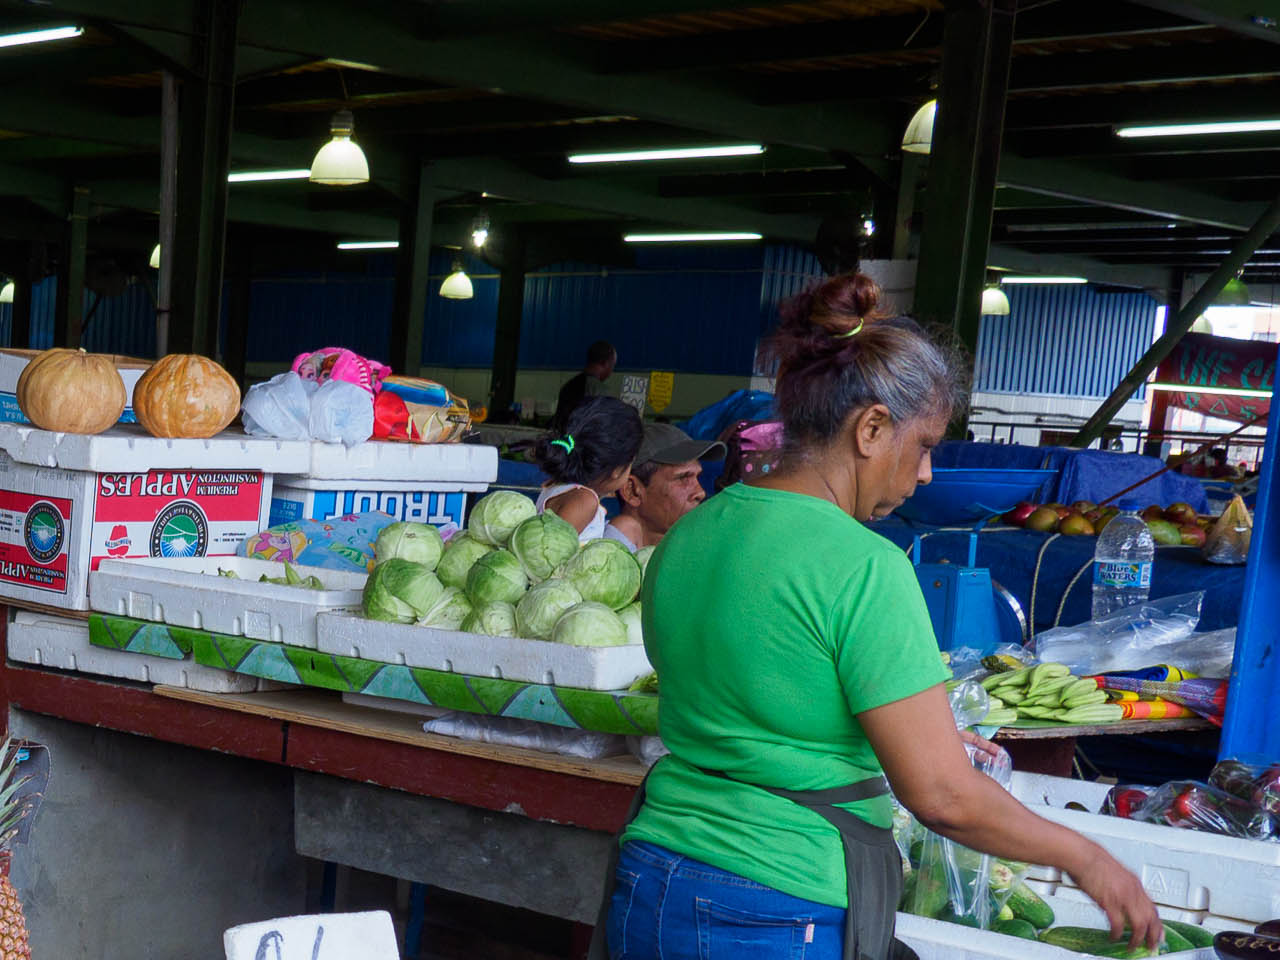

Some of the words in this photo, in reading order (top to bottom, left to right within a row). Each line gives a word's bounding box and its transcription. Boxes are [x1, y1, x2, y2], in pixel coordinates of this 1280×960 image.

[197, 473, 259, 484] WASHINGTON
[100, 472, 196, 497] APPLES
[196, 485, 239, 496] PREMIUM
